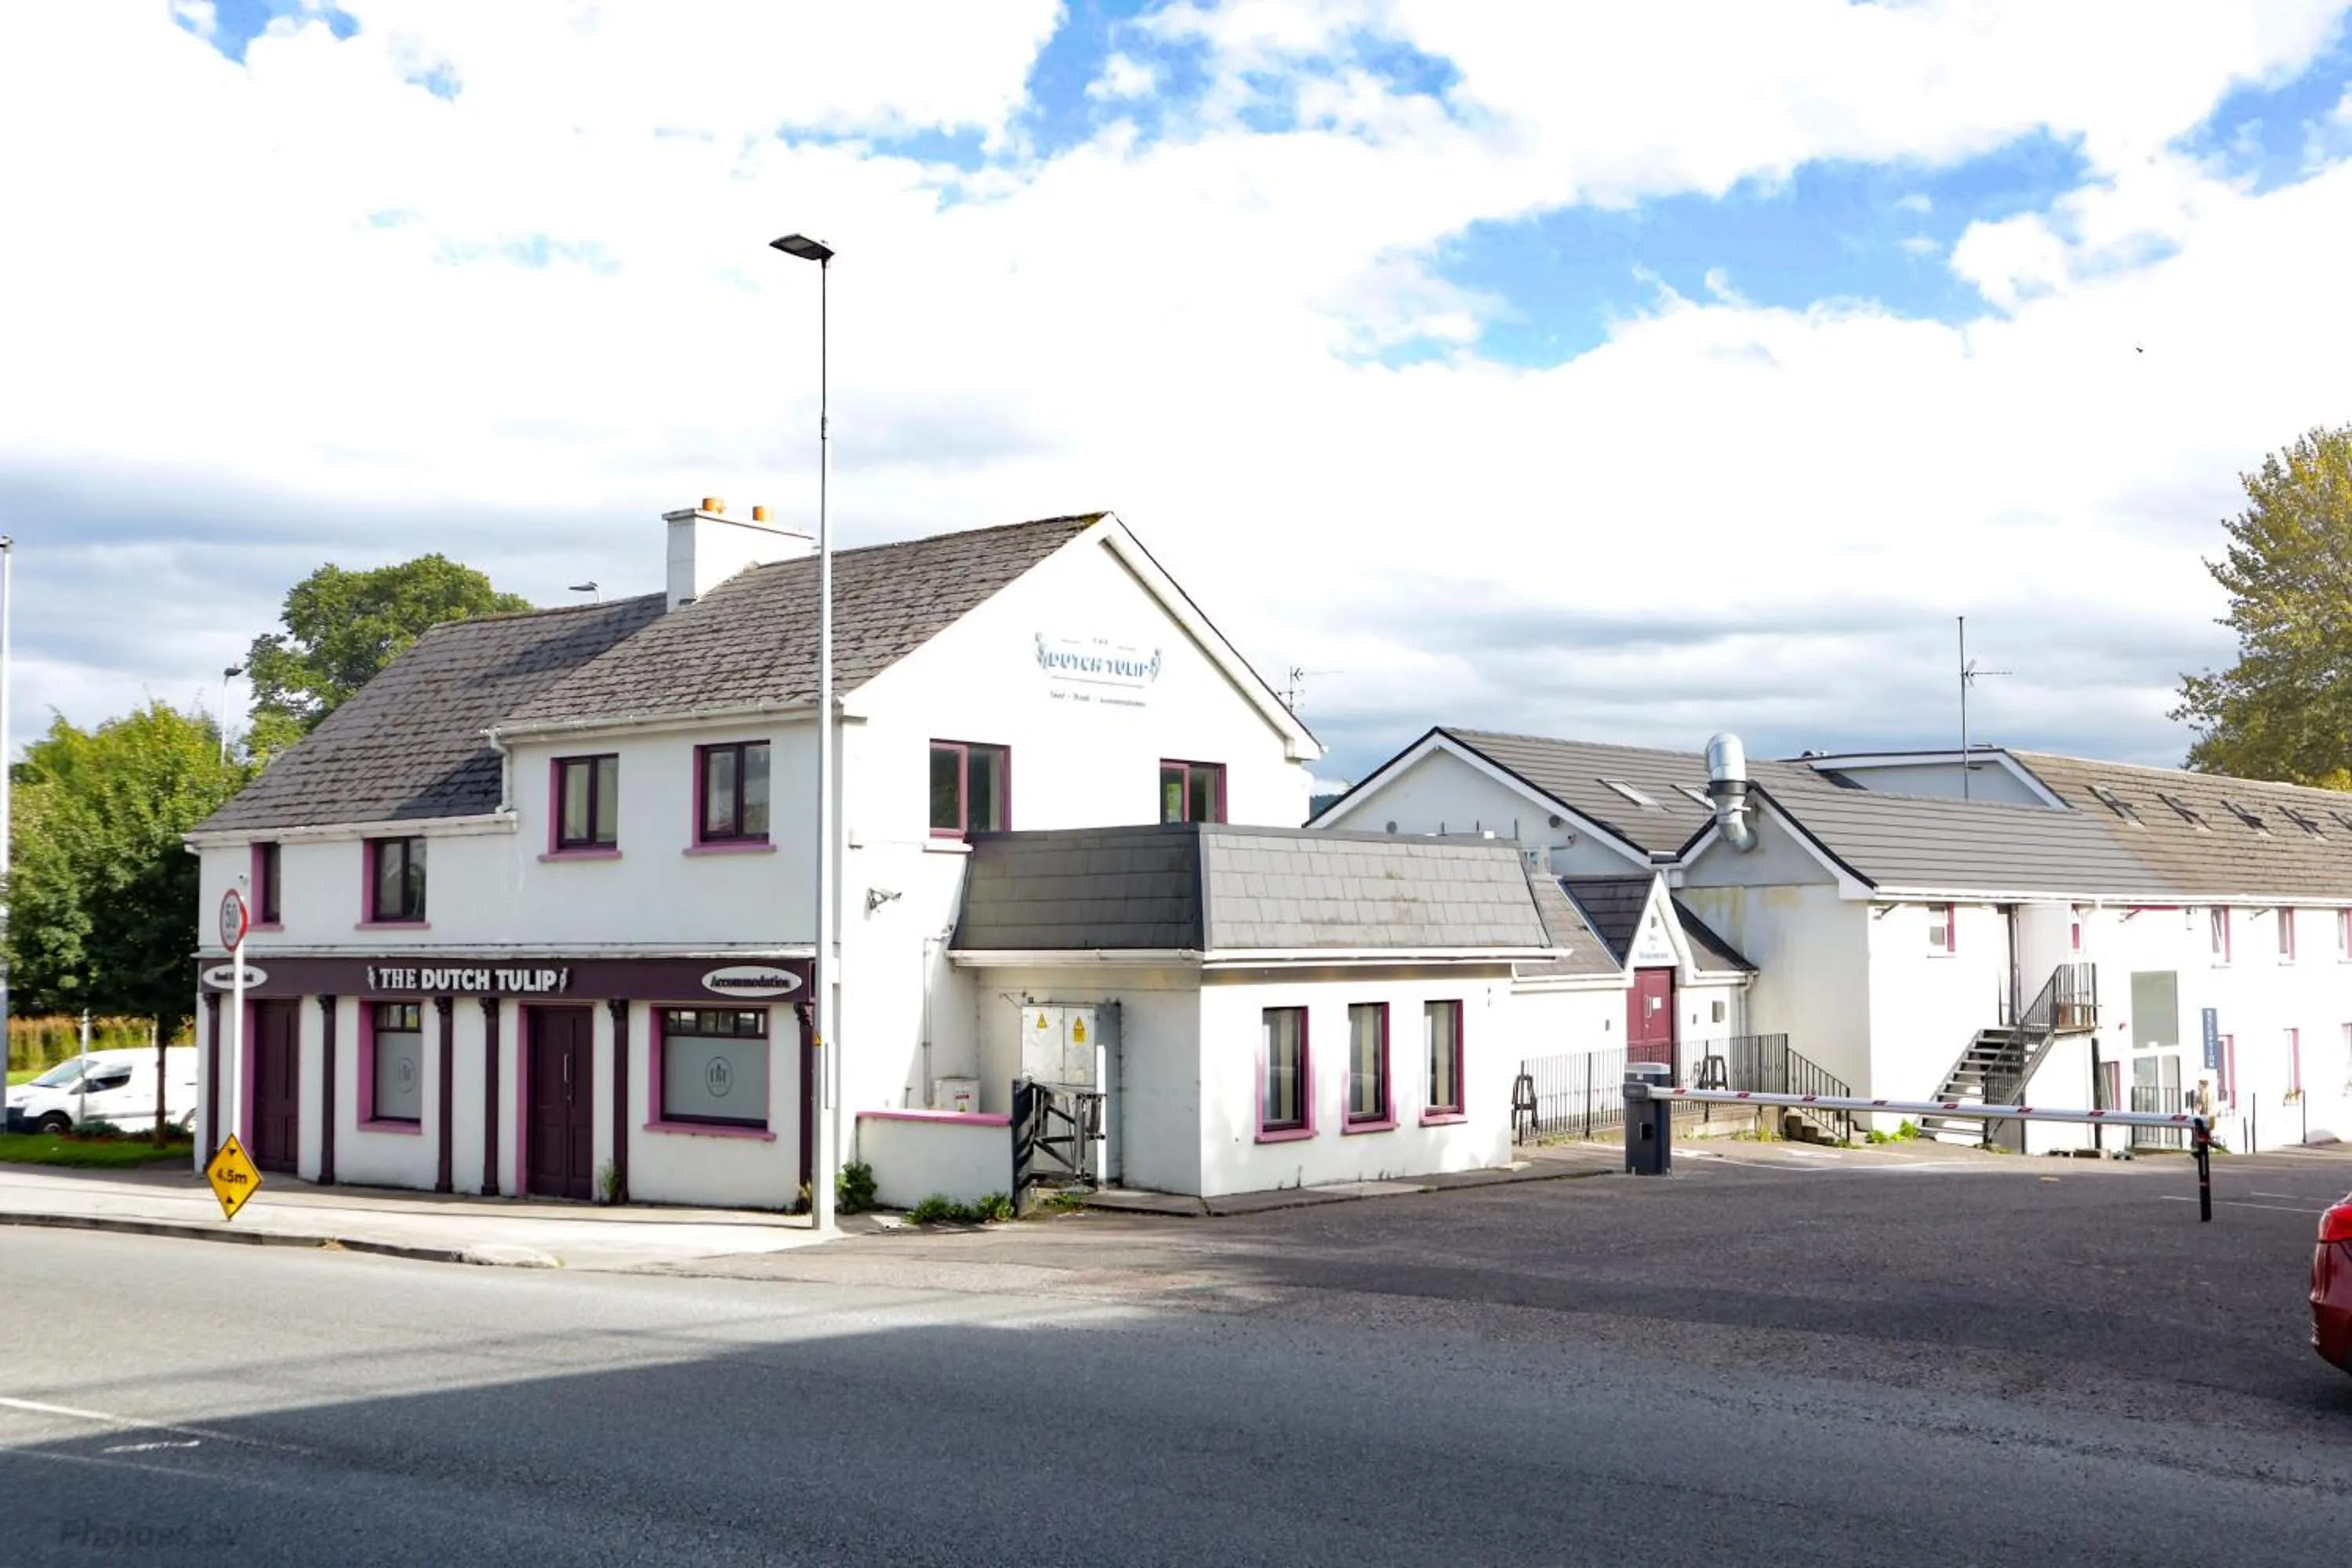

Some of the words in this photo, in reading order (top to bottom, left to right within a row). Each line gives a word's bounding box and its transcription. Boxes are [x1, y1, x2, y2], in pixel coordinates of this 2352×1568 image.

[1048, 652, 1102, 673] DUTCH
[1106, 659, 1148, 677] TULIP
[225, 903, 238, 929] 50
[379, 968, 417, 989] THE
[421, 968, 490, 991] DUTCH
[495, 970, 557, 992] TULIP
[710, 975, 790, 988] Accommodation
[216, 1167, 248, 1185] 4.5m
